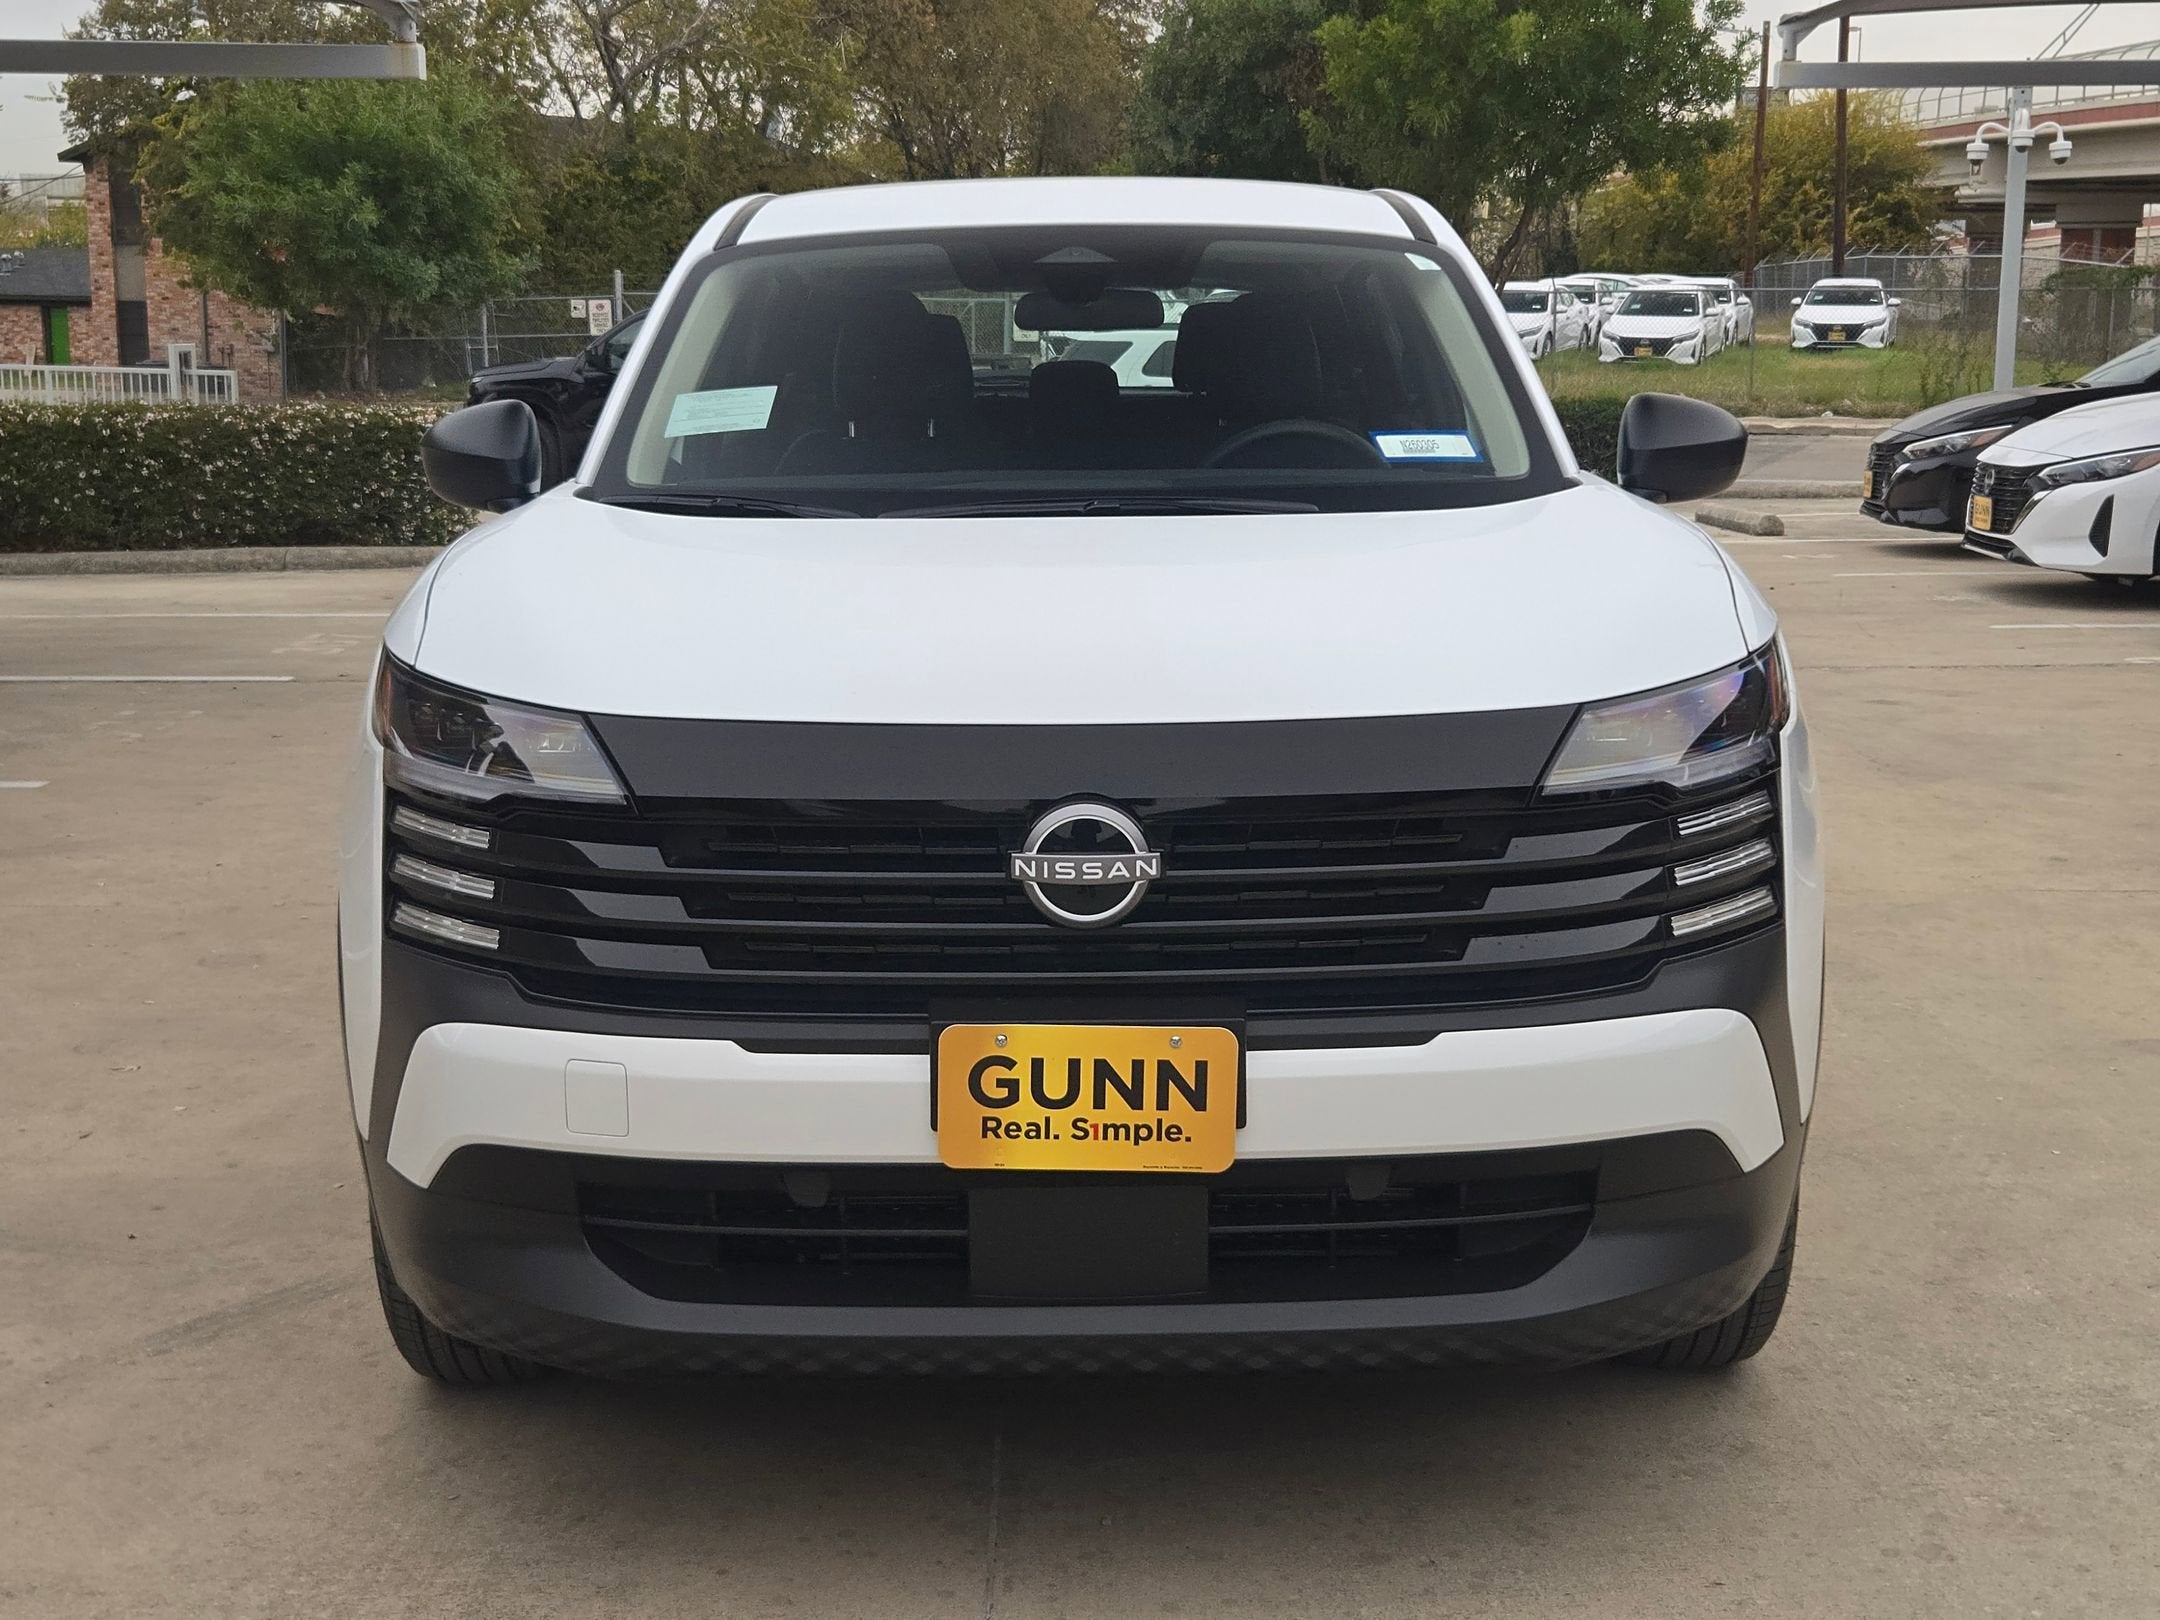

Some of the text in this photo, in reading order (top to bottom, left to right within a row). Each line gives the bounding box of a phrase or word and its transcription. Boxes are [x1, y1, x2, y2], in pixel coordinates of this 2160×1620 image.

[1015, 858, 1158, 880] NISSAN
[968, 1055, 1208, 1112] GUNN
[981, 1116, 1060, 1140] Real.
